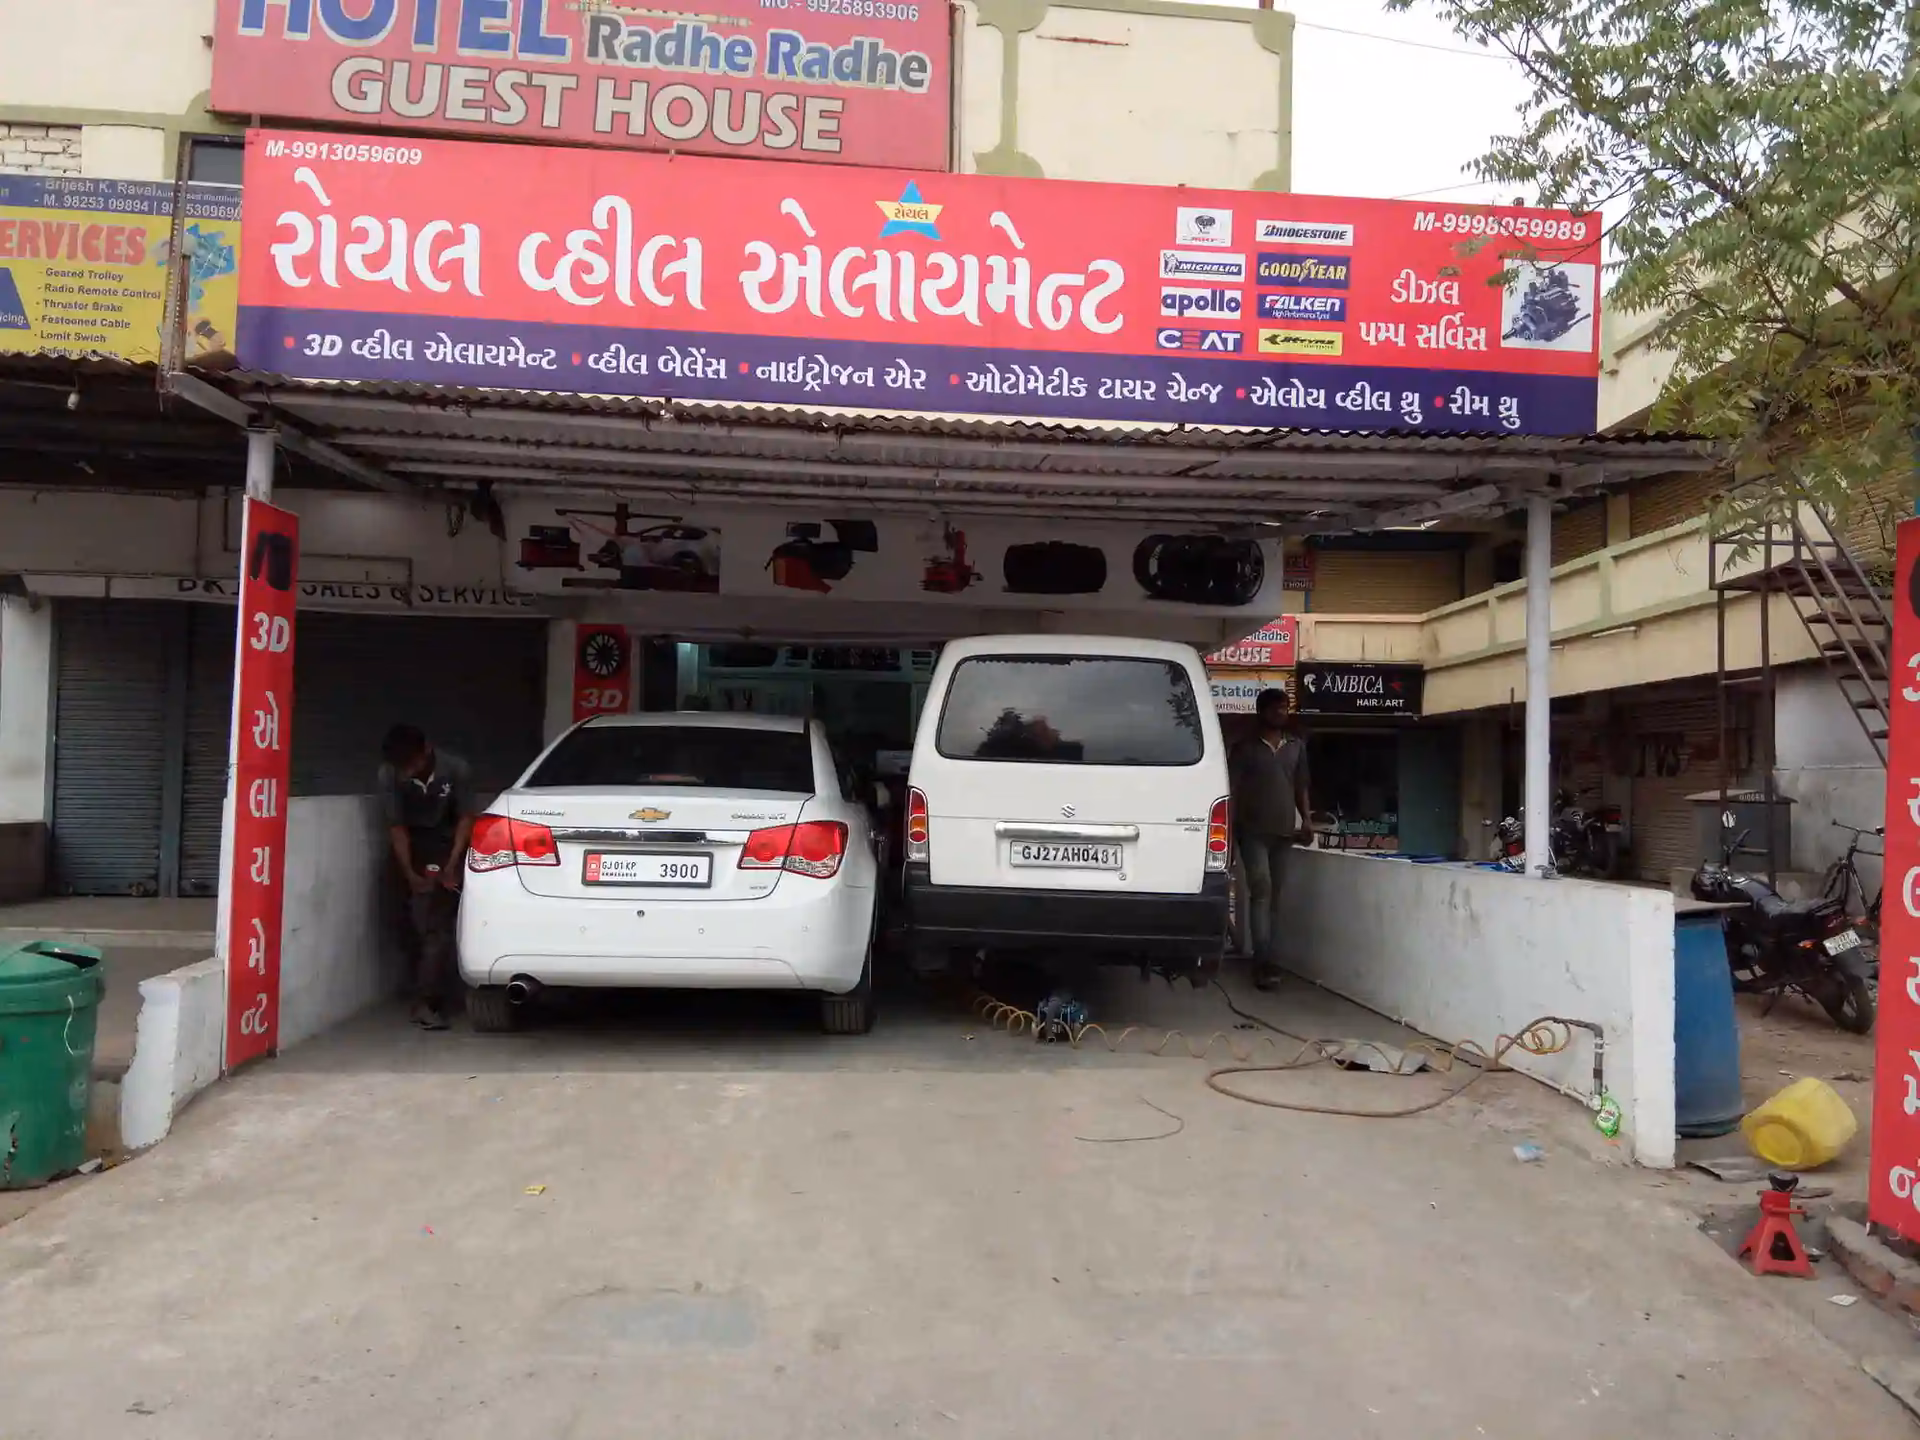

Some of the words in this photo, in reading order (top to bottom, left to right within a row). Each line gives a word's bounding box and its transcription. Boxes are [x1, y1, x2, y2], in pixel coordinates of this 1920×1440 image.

[585, 14, 755, 75] Radhe
[765, 29, 931, 92] Radhe
[331, 56, 579, 129] GUEST
[593, 76, 845, 153] HOUSE
[264, 140, 423, 165] M-9913059609
[45, 179, 94, 196] Brijesh
[117, 183, 156, 196] Raval
[63, 195, 104, 210] 98253
[1263, 224, 1348, 241] BRIDGESTONE
[1413, 211, 1587, 242] M-9998059989
[270, 166, 485, 297] રોયલ
[518, 195, 707, 310] વ્હીલ
[738, 197, 1125, 335] એલાયમેન્ટ
[45, 267, 84, 279] Geared
[88, 270, 124, 283] Trolley
[1179, 262, 1240, 274] MICHELIN
[44, 284, 74, 294] Radio
[78, 285, 119, 297] Remote
[121, 288, 161, 300] Control
[1390, 269, 1460, 305] ડીઝલ
[1161, 288, 1241, 317] apollo
[100, 318, 132, 330] Cable
[1359, 321, 1406, 347] પમ્પ
[1157, 329, 1242, 351] CEAT
[304, 334, 343, 356] 3D
[351, 329, 414, 361] વ્હીલ
[424, 332, 558, 370] એલાયમેન્ટ
[587, 343, 649, 376] વ્હીલ
[883, 358, 927, 390] એર
[1098, 377, 1157, 401] ટાયર
[1250, 377, 1327, 410] એલોય
[1335, 381, 1392, 412] વ્હીલ
[1449, 385, 1490, 416] રીમ
[419, 584, 533, 607] SERVIC
[250, 612, 290, 653] 3D
[1322, 671, 1385, 694] AMBICA
[580, 687, 623, 709] 3D
[1356, 698, 1378, 707] HAIR
[1384, 699, 1404, 708] ART
[659, 863, 699, 880] 3900
